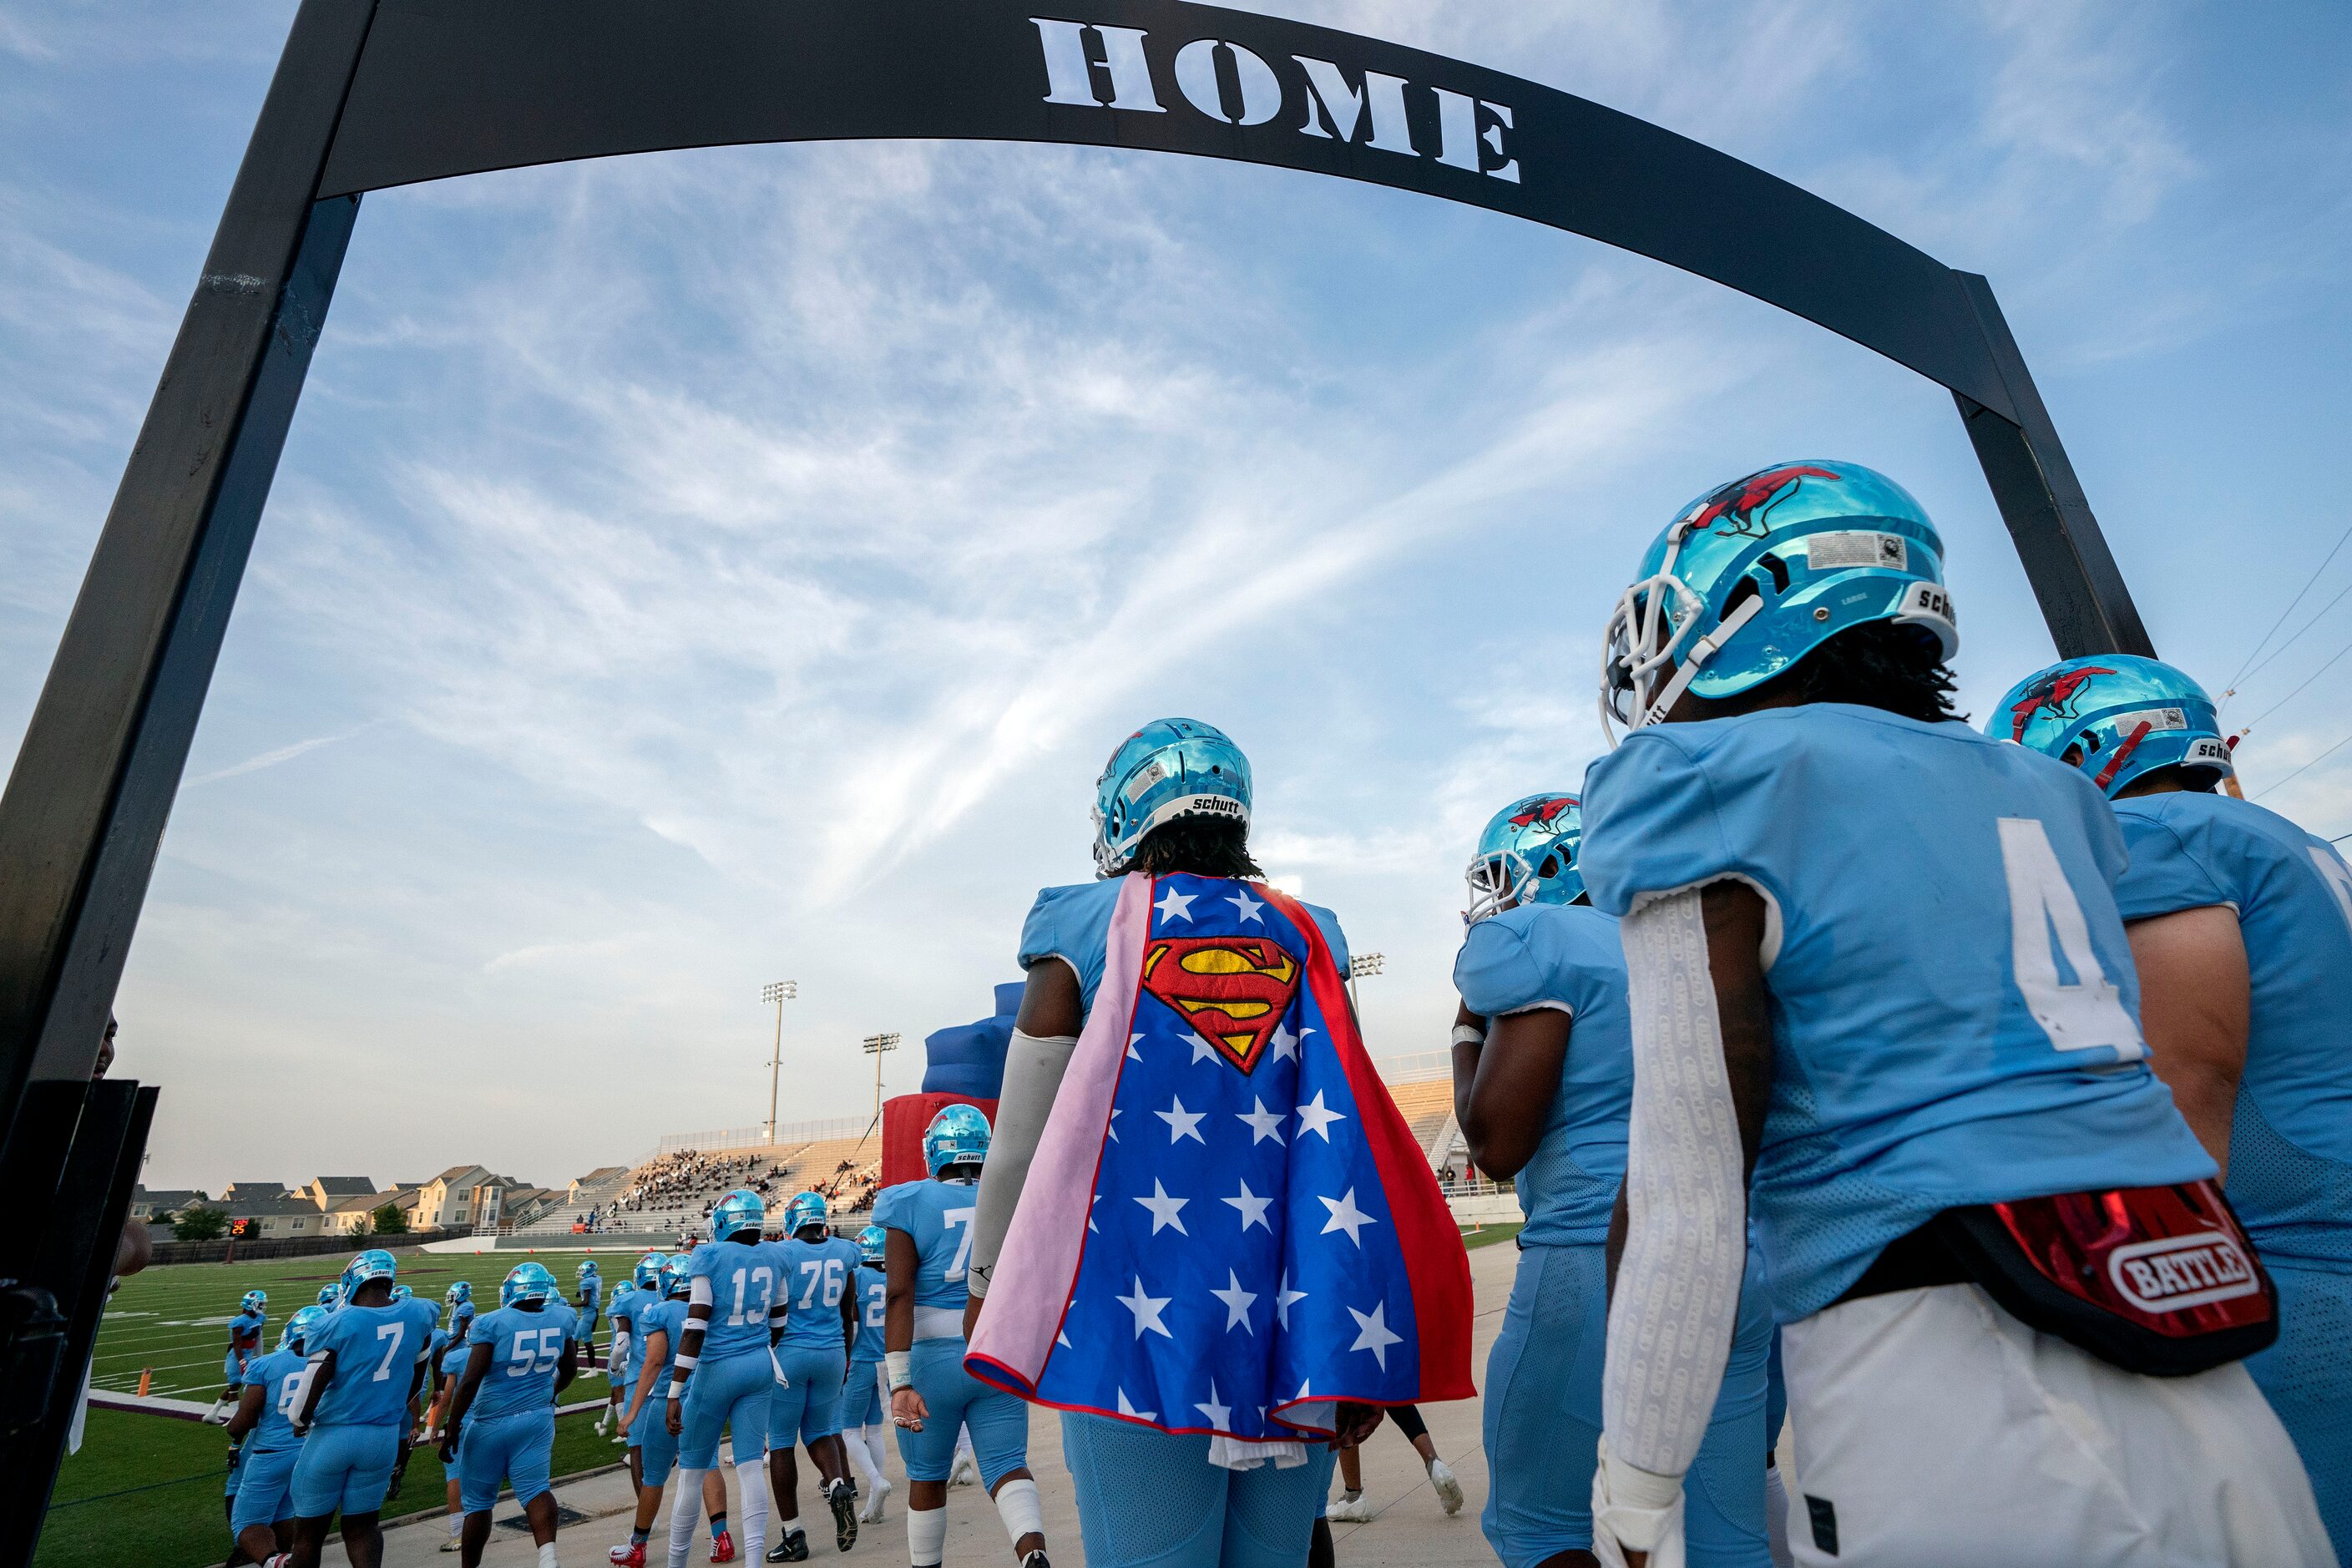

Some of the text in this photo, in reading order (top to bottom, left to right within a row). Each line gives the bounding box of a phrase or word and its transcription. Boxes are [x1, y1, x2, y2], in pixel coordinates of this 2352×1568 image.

[1029, 15, 1520, 184] HOME
[1193, 796, 1239, 814] schutt
[1997, 817, 2144, 1062] 4
[232, 1225, 245, 1235] 25
[727, 1266, 772, 1327] 13
[798, 1259, 843, 1310] 76
[2123, 1244, 2247, 1300] BATTLE
[373, 1322, 404, 1382] 7
[507, 1328, 561, 1378] 55
